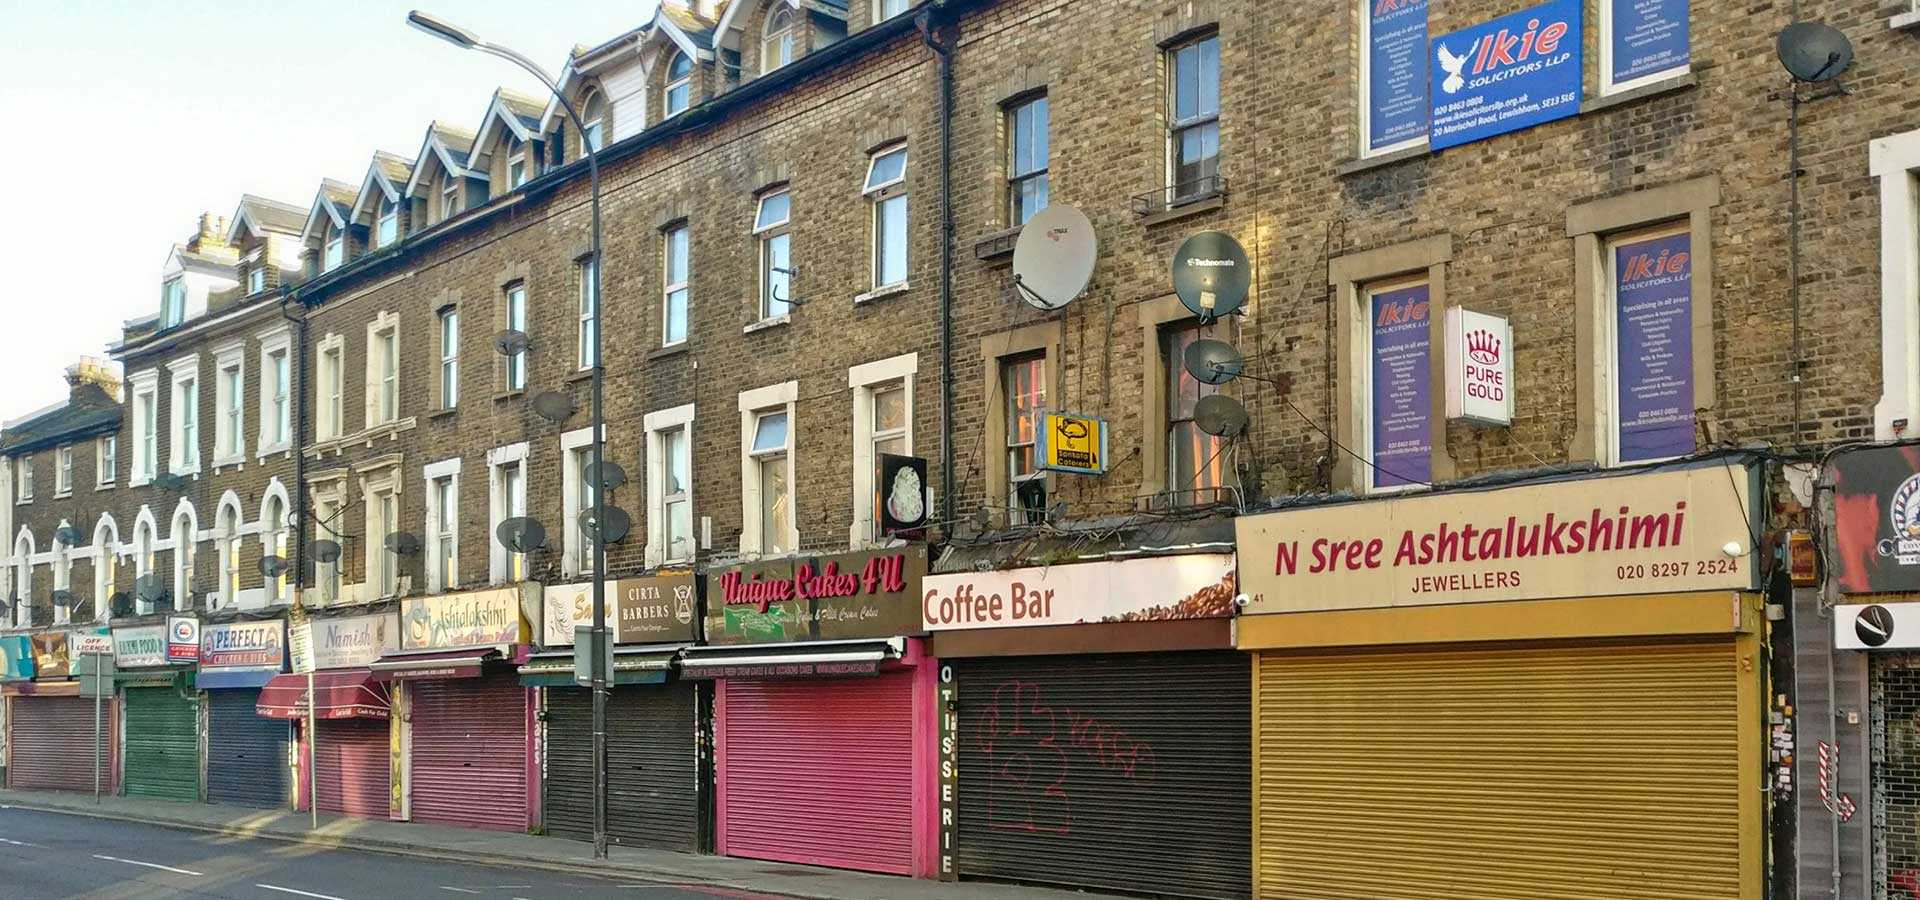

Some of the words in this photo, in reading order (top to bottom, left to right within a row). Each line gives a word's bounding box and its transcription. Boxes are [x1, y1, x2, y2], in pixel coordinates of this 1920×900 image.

[1472, 18, 1568, 75] Ikie
[1468, 60, 1542, 90] SOLICITORS
[1545, 53, 1570, 67] LLP
[1433, 127, 1443, 136] 20
[1541, 96, 1560, 109] SE13
[1434, 105, 1448, 116] 020
[1448, 101, 1465, 112] 8463
[1622, 249, 1690, 283] Ikie
[1620, 277, 1673, 292] SOLICITORS
[1376, 297, 1430, 327] Ikie
[1466, 365, 1503, 386] PURE
[1468, 383, 1504, 401] GOLD
[1275, 540, 1298, 576] N
[1309, 538, 1384, 574] Sree
[1393, 501, 1687, 567] Ashtalukshimi
[1412, 570, 1521, 594] JEWELLERS
[1617, 564, 1644, 580] 020
[1651, 561, 1689, 578] 8297
[1696, 559, 1738, 575] 2524
[628, 586, 660, 601] CIRTA
[719, 570, 795, 614] Unique
[794, 560, 860, 600] Cakes
[862, 553, 907, 595] 4U
[622, 604, 669, 620] BARBERS
[923, 583, 1002, 625] Coffee
[1011, 581, 1054, 620] Bar
[216, 628, 265, 649] PERFECT
[325, 624, 371, 649] Namish
[941, 665, 952, 872] OTISSERIE
